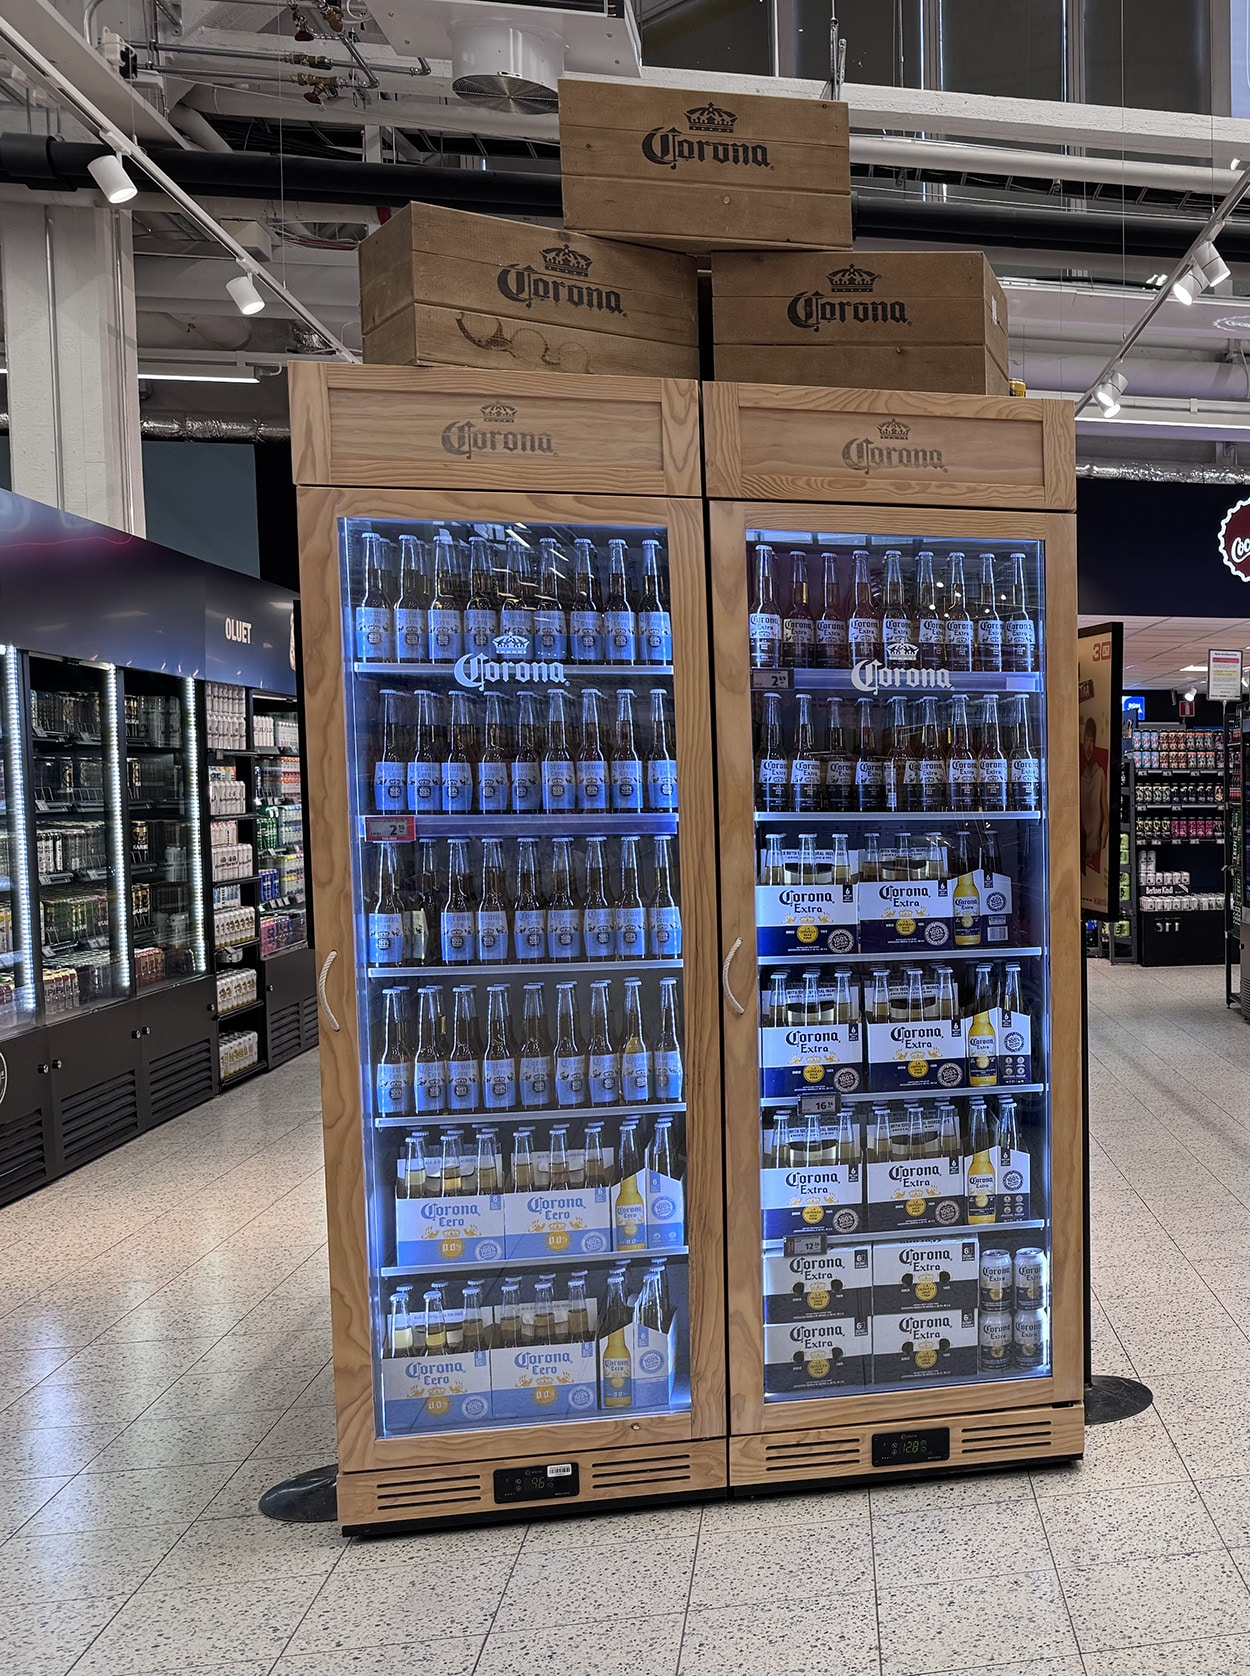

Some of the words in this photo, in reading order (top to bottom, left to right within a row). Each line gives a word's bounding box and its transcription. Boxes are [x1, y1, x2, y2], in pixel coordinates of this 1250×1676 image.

[641, 125, 770, 170] Corona
[497, 263, 624, 315] Corona
[787, 290, 908, 332] Corona
[441, 420, 554, 460] Corona
[842, 437, 945, 474] Corona
[784, 620, 812, 630] Corona
[817, 620, 845, 631] Corona
[851, 619, 878, 630] Corona
[224, 617, 252, 645] OLUET
[454, 652, 566, 691] Corona
[771, 676, 779, 687] 2
[851, 659, 951, 696] Corona
[389, 824, 398, 836] 2
[779, 889, 833, 907] Corona
[879, 885, 929, 902] Corona
[893, 898, 920, 908] Extra
[955, 898, 979, 906] Corona
[794, 904, 823, 914] Extra
[785, 1030, 839, 1048] Corona
[890, 1026, 942, 1043] Corona
[905, 1040, 932, 1050] Extra
[970, 1037, 994, 1046] Corona
[800, 1044, 829, 1054] Extra
[816, 1102, 827, 1110] 16
[889, 1165, 940, 1182] Corona
[786, 1172, 839, 1189] Corona
[903, 1178, 930, 1188] Extra
[969, 1176, 993, 1185] Corona
[800, 1184, 829, 1195] Extra
[527, 1196, 583, 1215] Corona
[617, 1206, 642, 1215] Corona
[420, 1202, 479, 1221] Corona
[544, 1210, 570, 1221] Cero
[439, 1217, 465, 1227] Cero
[899, 1248, 951, 1266] Corona
[789, 1257, 843, 1274] Corona
[913, 1262, 941, 1273] Extra
[983, 1266, 1010, 1276] Corona
[804, 1271, 833, 1281] Extra
[899, 1316, 951, 1335] Corona
[789, 1325, 843, 1343] Corona
[913, 1331, 941, 1340] Extra
[805, 1339, 833, 1349] Extra
[514, 1351, 571, 1370] Corona
[405, 1362, 464, 1380] Corona
[532, 1365, 557, 1376] Cero
[423, 1375, 450, 1386] Cero
